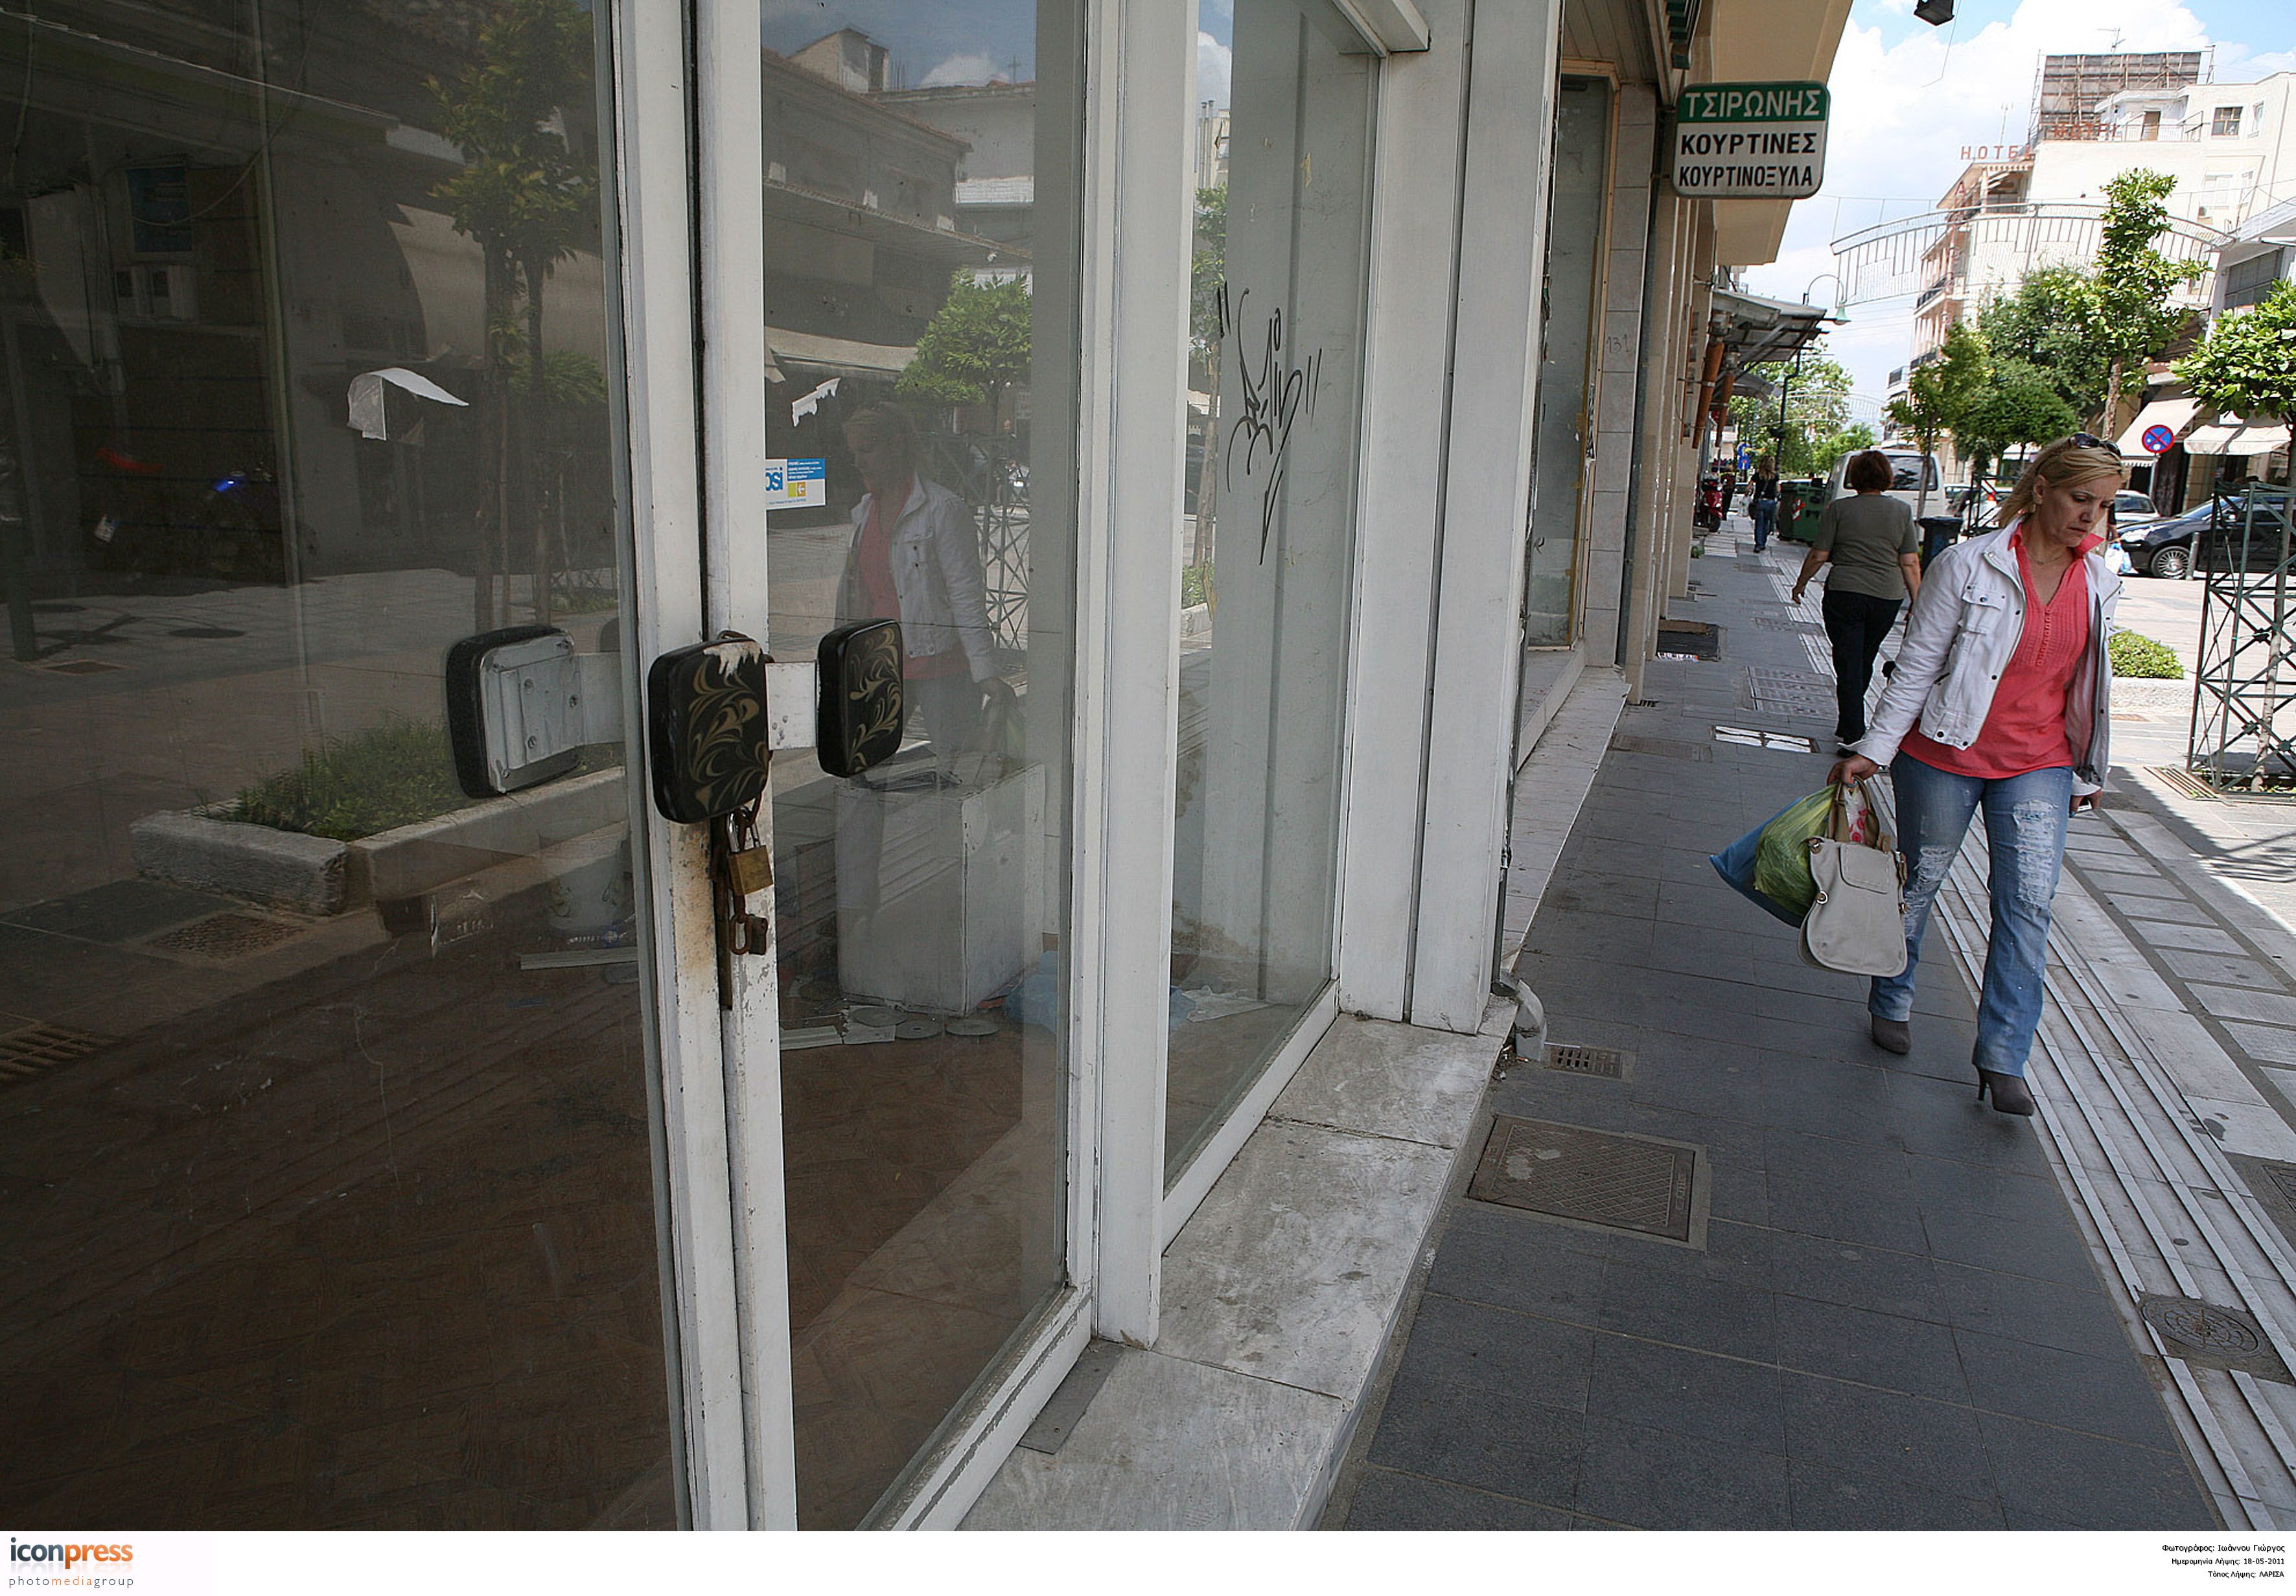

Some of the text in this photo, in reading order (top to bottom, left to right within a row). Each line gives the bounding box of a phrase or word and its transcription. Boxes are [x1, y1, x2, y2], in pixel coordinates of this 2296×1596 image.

[1684, 89, 1822, 118] ΤΣΙΡΩΝΗΣ
[1680, 132, 1817, 155] ΚΟΥΡΤΙΝΕΣ
[1678, 165, 1813, 187] ΚΟΥΡΤΙΝΟΞΥΛΑ
